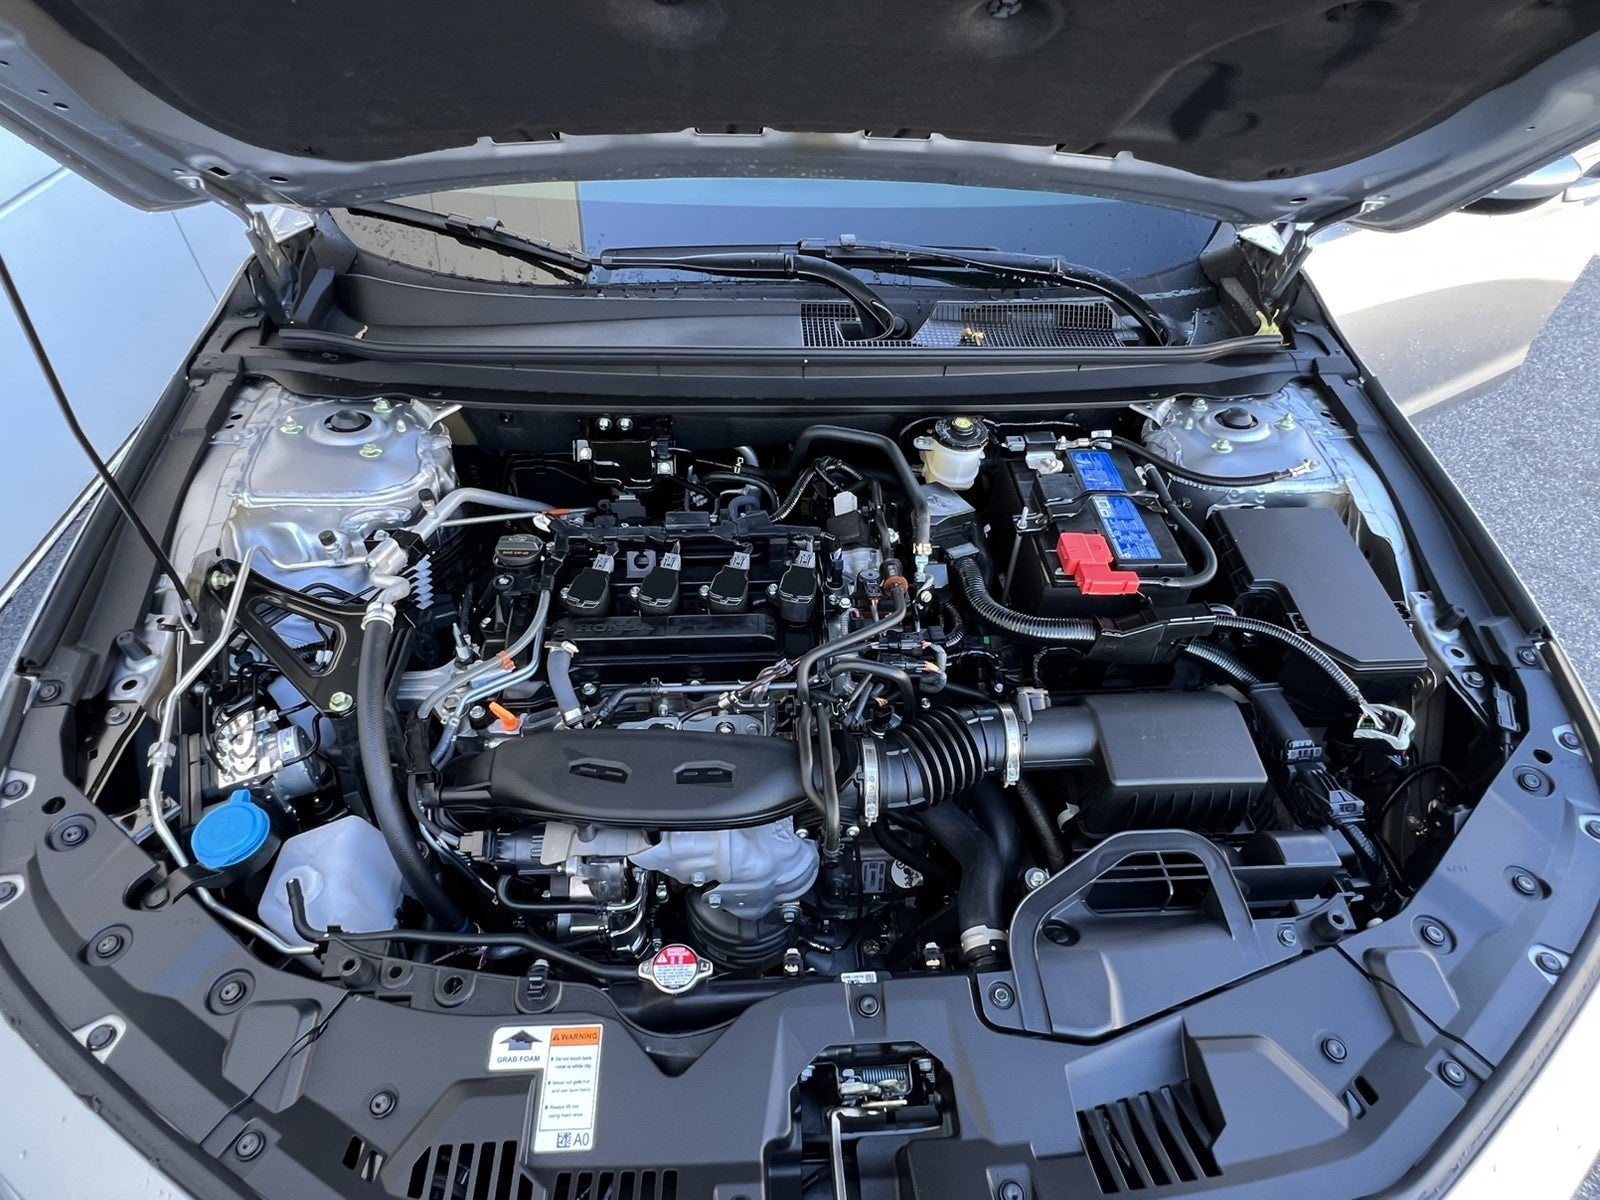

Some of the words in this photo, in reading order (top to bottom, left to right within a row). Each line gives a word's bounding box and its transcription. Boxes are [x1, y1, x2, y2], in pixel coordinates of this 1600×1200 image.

[562, 1032, 598, 1041] WARNING
[497, 1056, 518, 1064] GRAB
[519, 1055, 541, 1063] FOAM
[573, 1132, 590, 1146] A0
